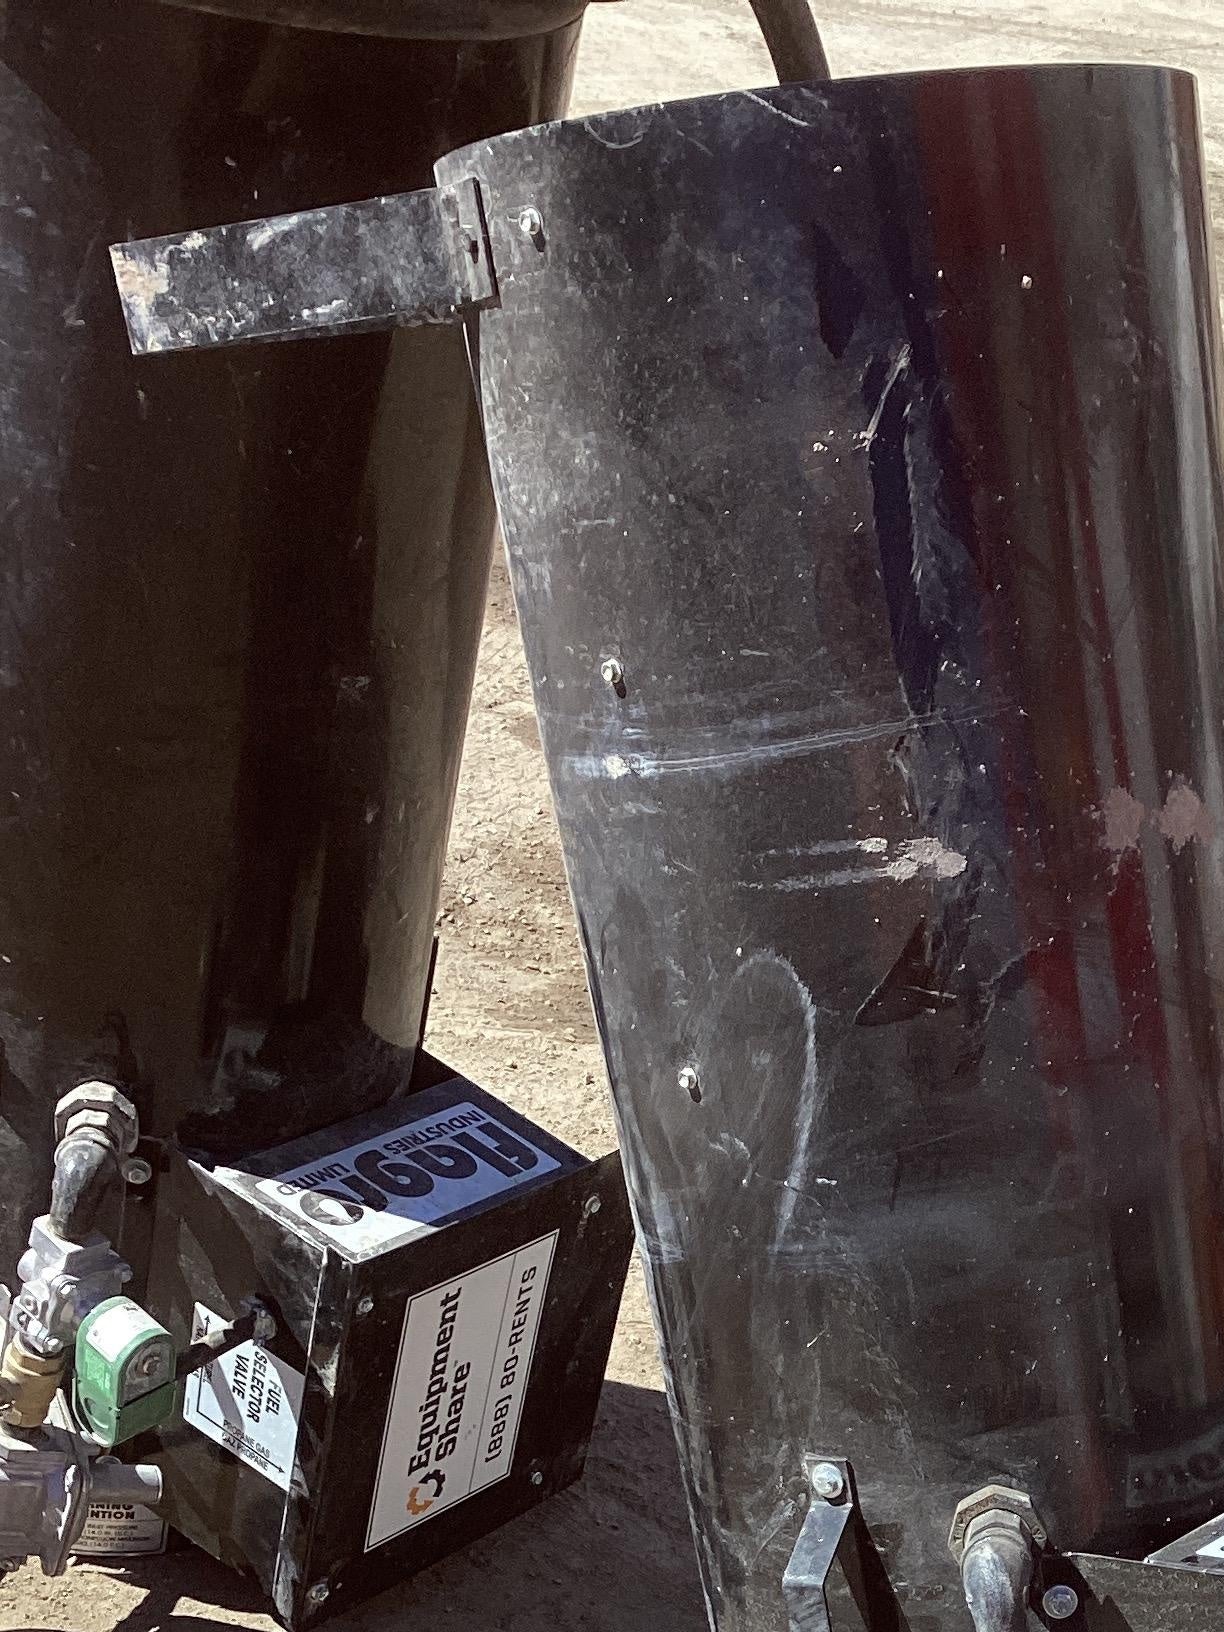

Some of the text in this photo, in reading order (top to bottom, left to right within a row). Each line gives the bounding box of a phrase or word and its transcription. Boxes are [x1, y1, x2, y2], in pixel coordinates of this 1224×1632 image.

[276, 1110, 487, 1196] INDUSTRIES LIMITED
[232, 1353, 250, 1400] VALVE
[247, 1351, 268, 1424] SELECTOR
[264, 1379, 282, 1416] FUEL
[408, 1286, 462, 1477] Equipment
[485, 1265, 537, 1463] (888) 80-RENTS
[222, 1419, 271, 1459] PROPANE GAS
[435, 1361, 471, 1462] Share
